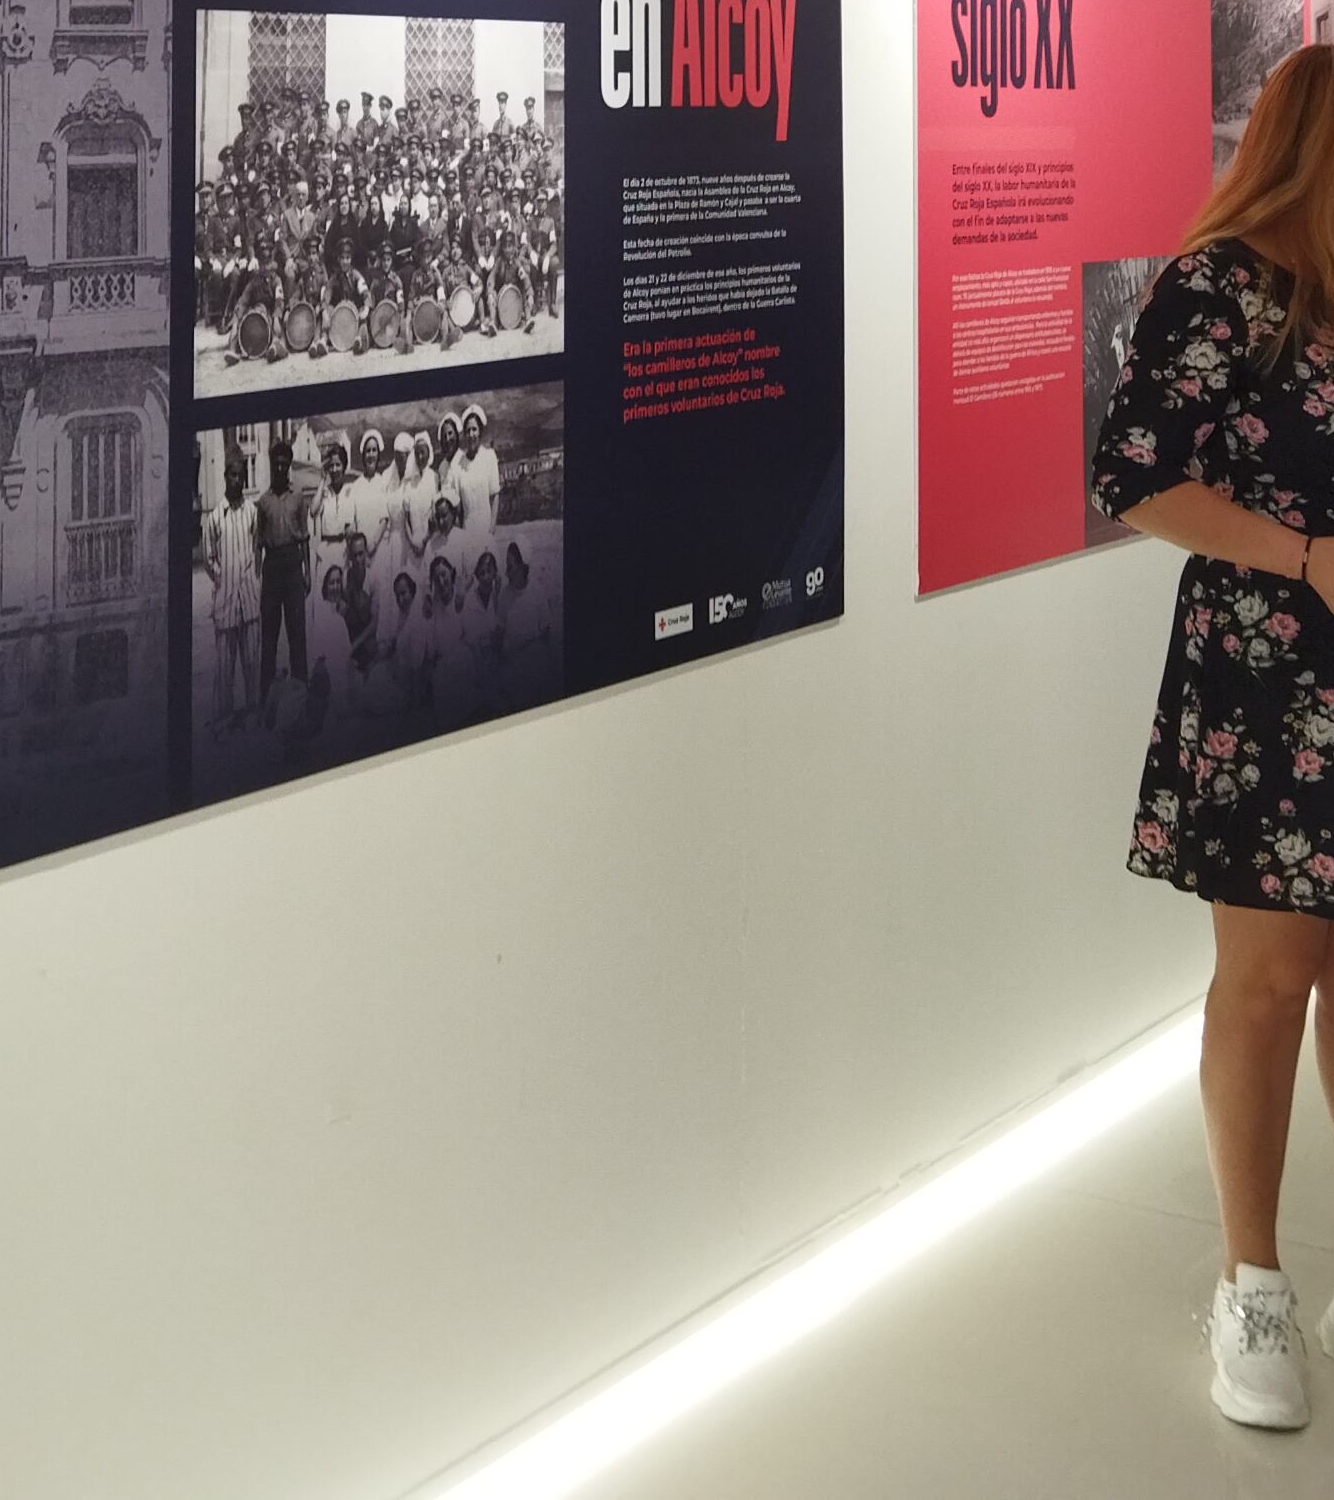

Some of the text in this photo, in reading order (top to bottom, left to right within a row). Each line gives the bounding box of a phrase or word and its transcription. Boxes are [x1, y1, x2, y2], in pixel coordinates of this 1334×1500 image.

[953, 164, 971, 175] Entre
[973, 164, 995, 174] finales
[997, 163, 1008, 174] del
[1009, 163, 1024, 176] siglo
[1026, 163, 1036, 173] XIX
[1038, 165, 1041, 175] y
[952, 182, 963, 192] del
[965, 181, 981, 194] siglo
[995, 181, 1000, 191] la
[1003, 180, 1019, 191] labor
[1021, 179, 1059, 190] humanitaria
[1061, 179, 1069, 189] de
[1071, 179, 1076, 188] la
[953, 199, 968, 210] Cruz
[970, 198, 984, 212] Roja
[987, 197, 1016, 211] Española
[1028, 195, 1074, 207] evolucionando
[953, 212, 1068, 228] con el fin de adaptarse a las nuevas
[953, 232, 988, 245] demandas
[991, 231, 998, 242] de
[1000, 231, 1006, 242] la
[624, 329, 755, 356] Era la primera actuación de
[646, 355, 696, 374] camilleros
[698, 353, 711, 367] de
[745, 345, 780, 361] nombre
[623, 368, 765, 399] con el que eran conocidos los
[624, 400, 669, 424] primeros
[671, 392, 725, 413] voluntarios
[727, 391, 739, 405] de
[741, 388, 761, 403] Cruz
